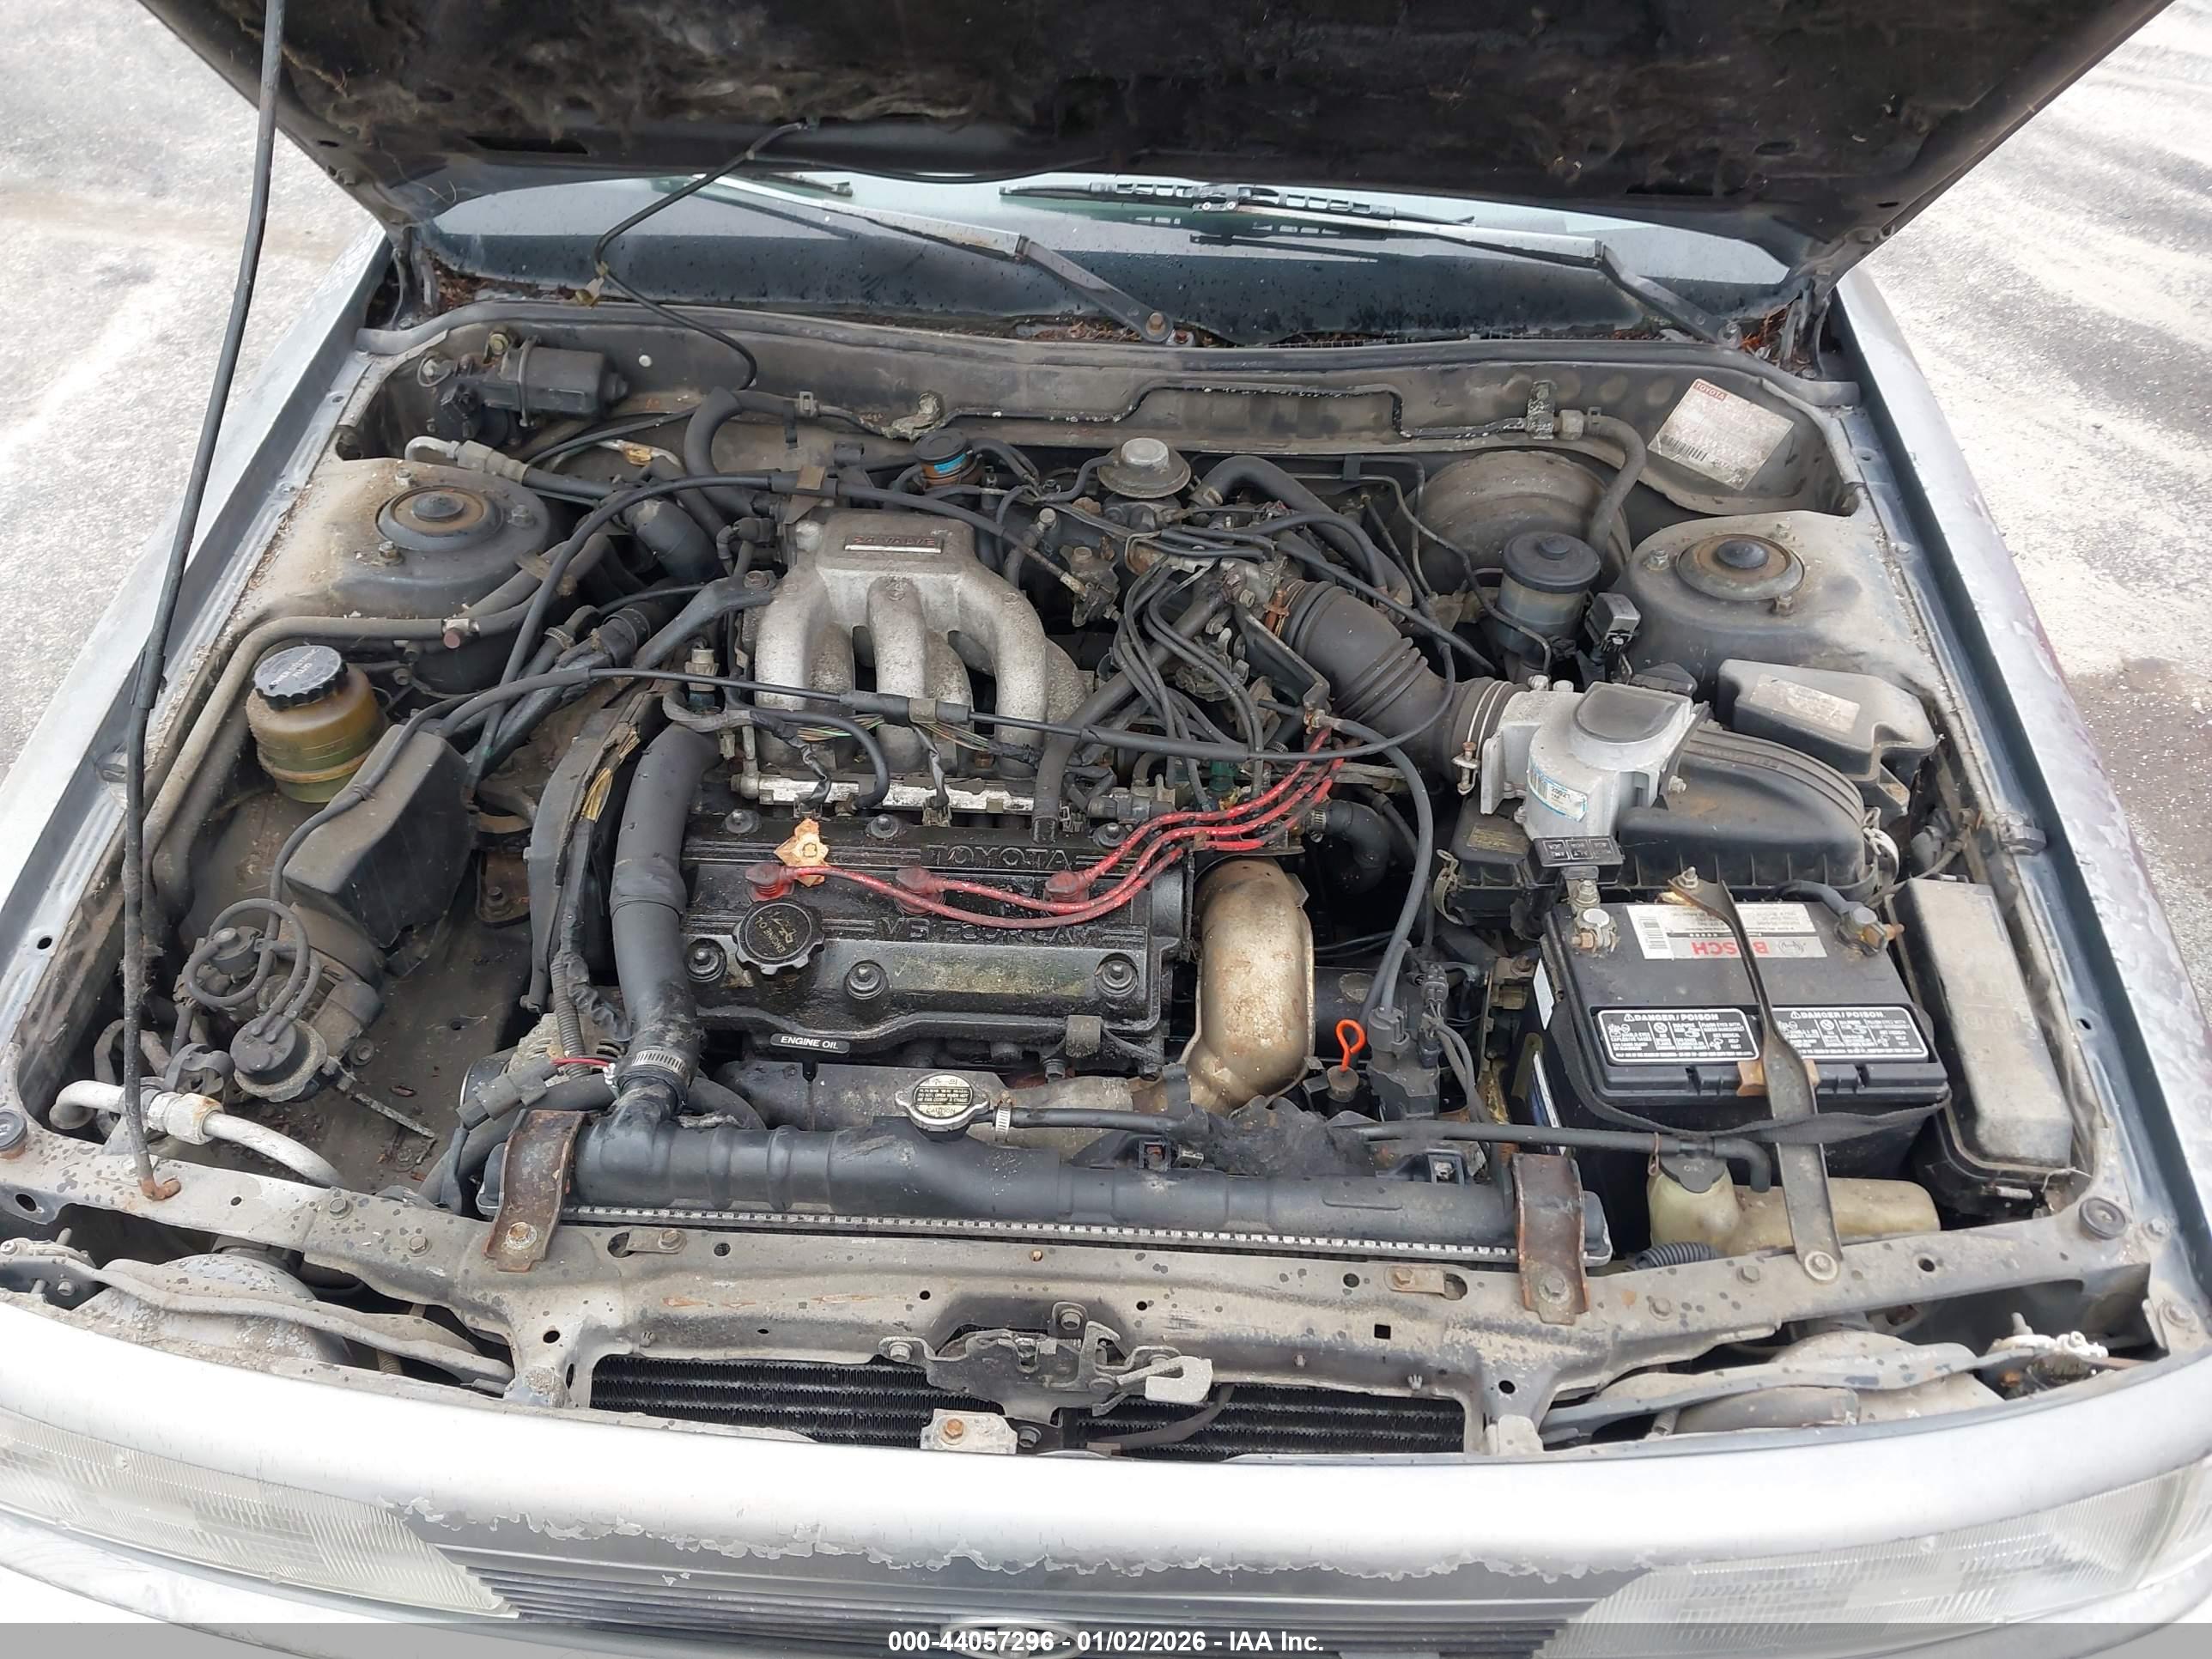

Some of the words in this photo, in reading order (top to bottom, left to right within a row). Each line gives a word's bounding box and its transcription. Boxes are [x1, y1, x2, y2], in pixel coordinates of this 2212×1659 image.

[1695, 382, 1725, 400] TOYOTA
[882, 536, 935, 545] VALVE
[927, 845, 1073, 869] TOYOTA
[763, 928, 786, 953] ENGINE
[1691, 940, 1770, 956] BSCH
[781, 1036, 820, 1048] ENGINE
[822, 1040, 838, 1049] OIL
